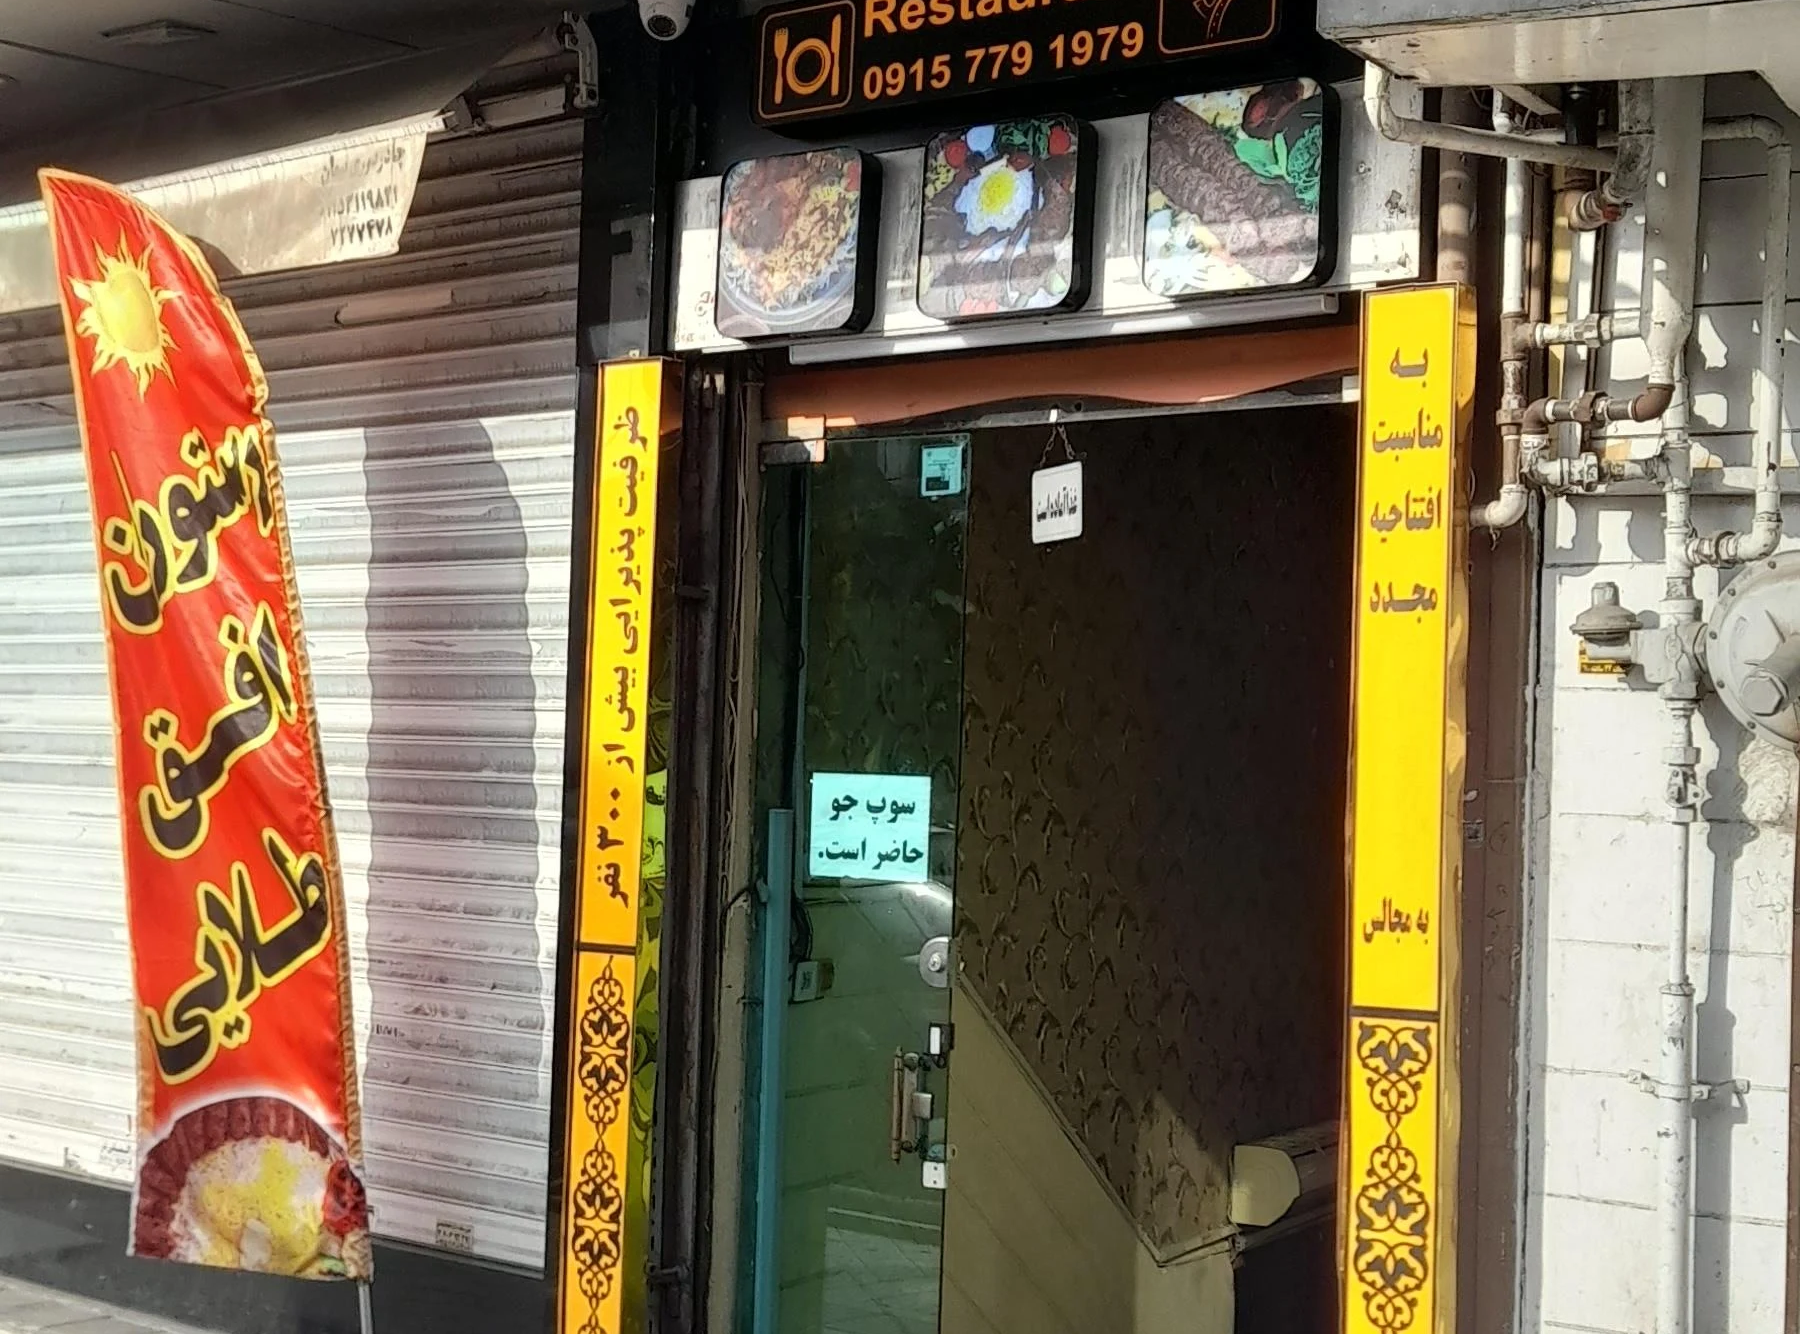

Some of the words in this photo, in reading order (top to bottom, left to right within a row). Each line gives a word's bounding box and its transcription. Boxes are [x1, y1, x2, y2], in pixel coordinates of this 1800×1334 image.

[863, 53, 951, 100] 0915
[965, 40, 1033, 84] 779
[1049, 21, 1145, 69] 1979
[1389, 346, 1429, 388] به
[1372, 407, 1444, 463] مناسبت
[612, 405, 648, 518] ظرفیت
[103, 425, 275, 634] رستورن
[1369, 486, 1443, 544] افتتاحیه
[608, 525, 646, 655] پذیرایی
[1369, 580, 1439, 624] مجدد
[604, 665, 637, 733] بیش
[138, 601, 298, 856] افق
[602, 743, 634, 774] از
[596, 786, 625, 851] ۳۰۰
[829, 794, 859, 821] جو
[865, 796, 916, 825] سوپ
[818, 837, 867, 860] است.
[872, 840, 924, 870] حاضر
[596, 861, 629, 909] نفر
[1362, 896, 1412, 944] مجالس
[1416, 907, 1429, 945] به
[144, 827, 332, 1085] طلایی
